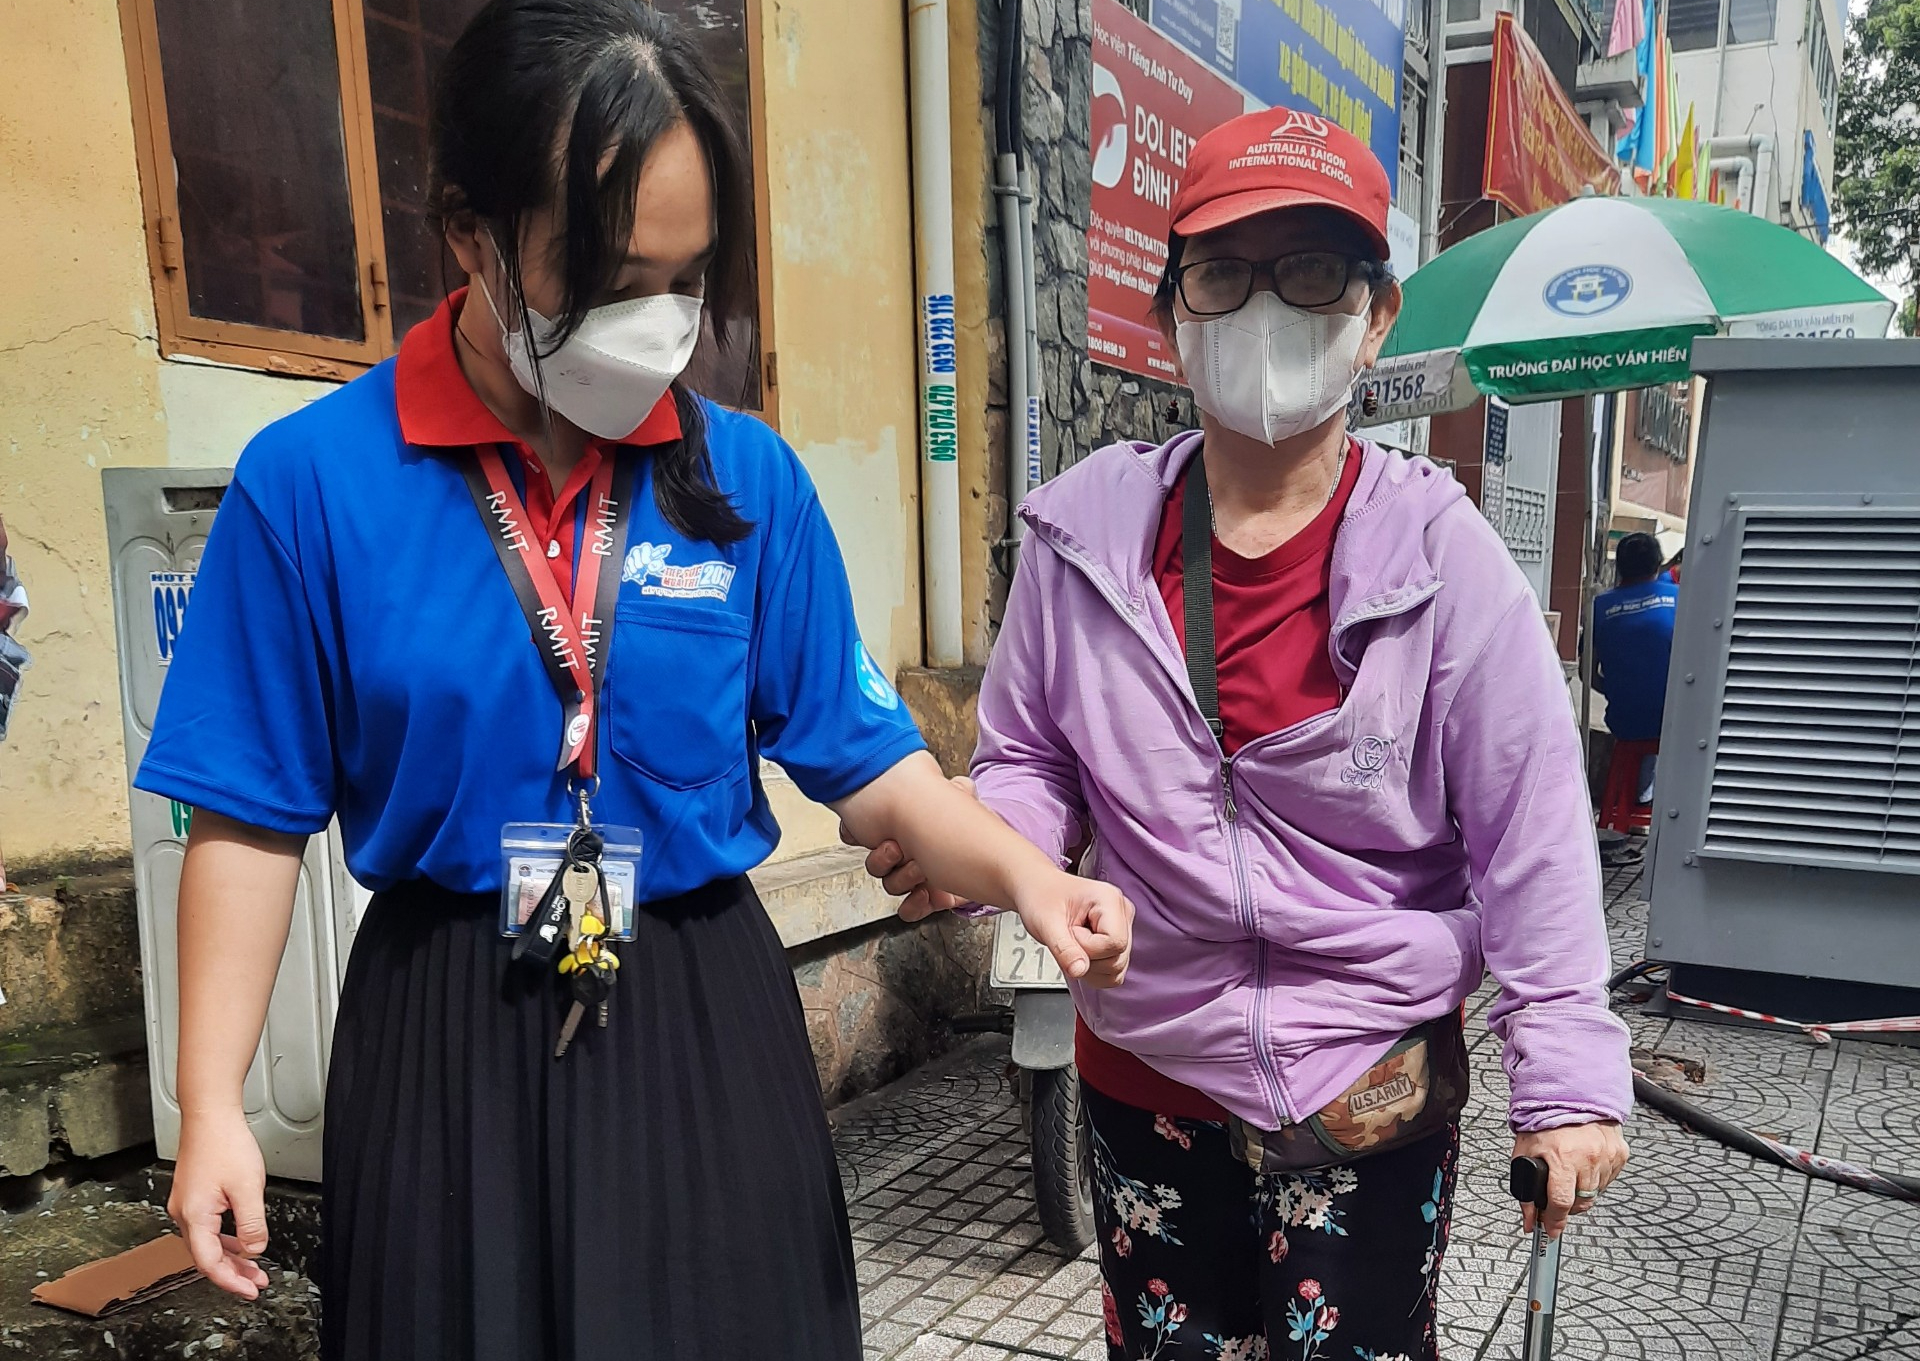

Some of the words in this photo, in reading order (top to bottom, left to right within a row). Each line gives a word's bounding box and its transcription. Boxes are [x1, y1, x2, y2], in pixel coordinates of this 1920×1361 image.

[1093, 20, 1109, 46] Học
[1110, 33, 1126, 57] viện
[1127, 41, 1150, 77] Tiếng
[1151, 59, 1167, 85] Anh
[1167, 69, 1178, 93] Tư
[1178, 77, 1194, 105] Duy
[1135, 104, 1167, 158] DOL
[1229, 155, 1318, 171] INTERNATIONAL
[1320, 162, 1353, 189] SCHOOL
[1246, 142, 1307, 156] AUSTRALIA
[1310, 147, 1346, 170] SAIGON
[1133, 152, 1170, 211] ĐÌNH
[1090, 210, 1103, 231] Độc
[1104, 221, 1125, 240] quyền
[1089, 236, 1100, 252] với
[1101, 241, 1125, 266] phương
[1126, 251, 1142, 271] pháp
[1089, 258, 1104, 279] giúp
[1105, 263, 1121, 286] tăng
[1121, 270, 1137, 289] điểm
[928, 294, 955, 316] 116
[930, 317, 956, 340] 228
[932, 343, 957, 374] 0939
[1488, 360, 1549, 380] TRƯỜNG
[1551, 357, 1577, 375] ĐẠI
[1581, 355, 1612, 372] HỌC
[1616, 350, 1648, 368] VĂN
[1651, 346, 1688, 363] HIẾN
[928, 385, 956, 409] 470
[1349, 373, 1426, 408] 001568
[929, 409, 957, 430] 074
[929, 432, 957, 462] 0963
[486, 490, 530, 551] RMIT
[592, 492, 618, 556] RMIT
[154, 587, 194, 661] 093
[536, 606, 580, 670] RMIT
[581, 612, 603, 677] MIT
[1009, 946, 1063, 980] 21
